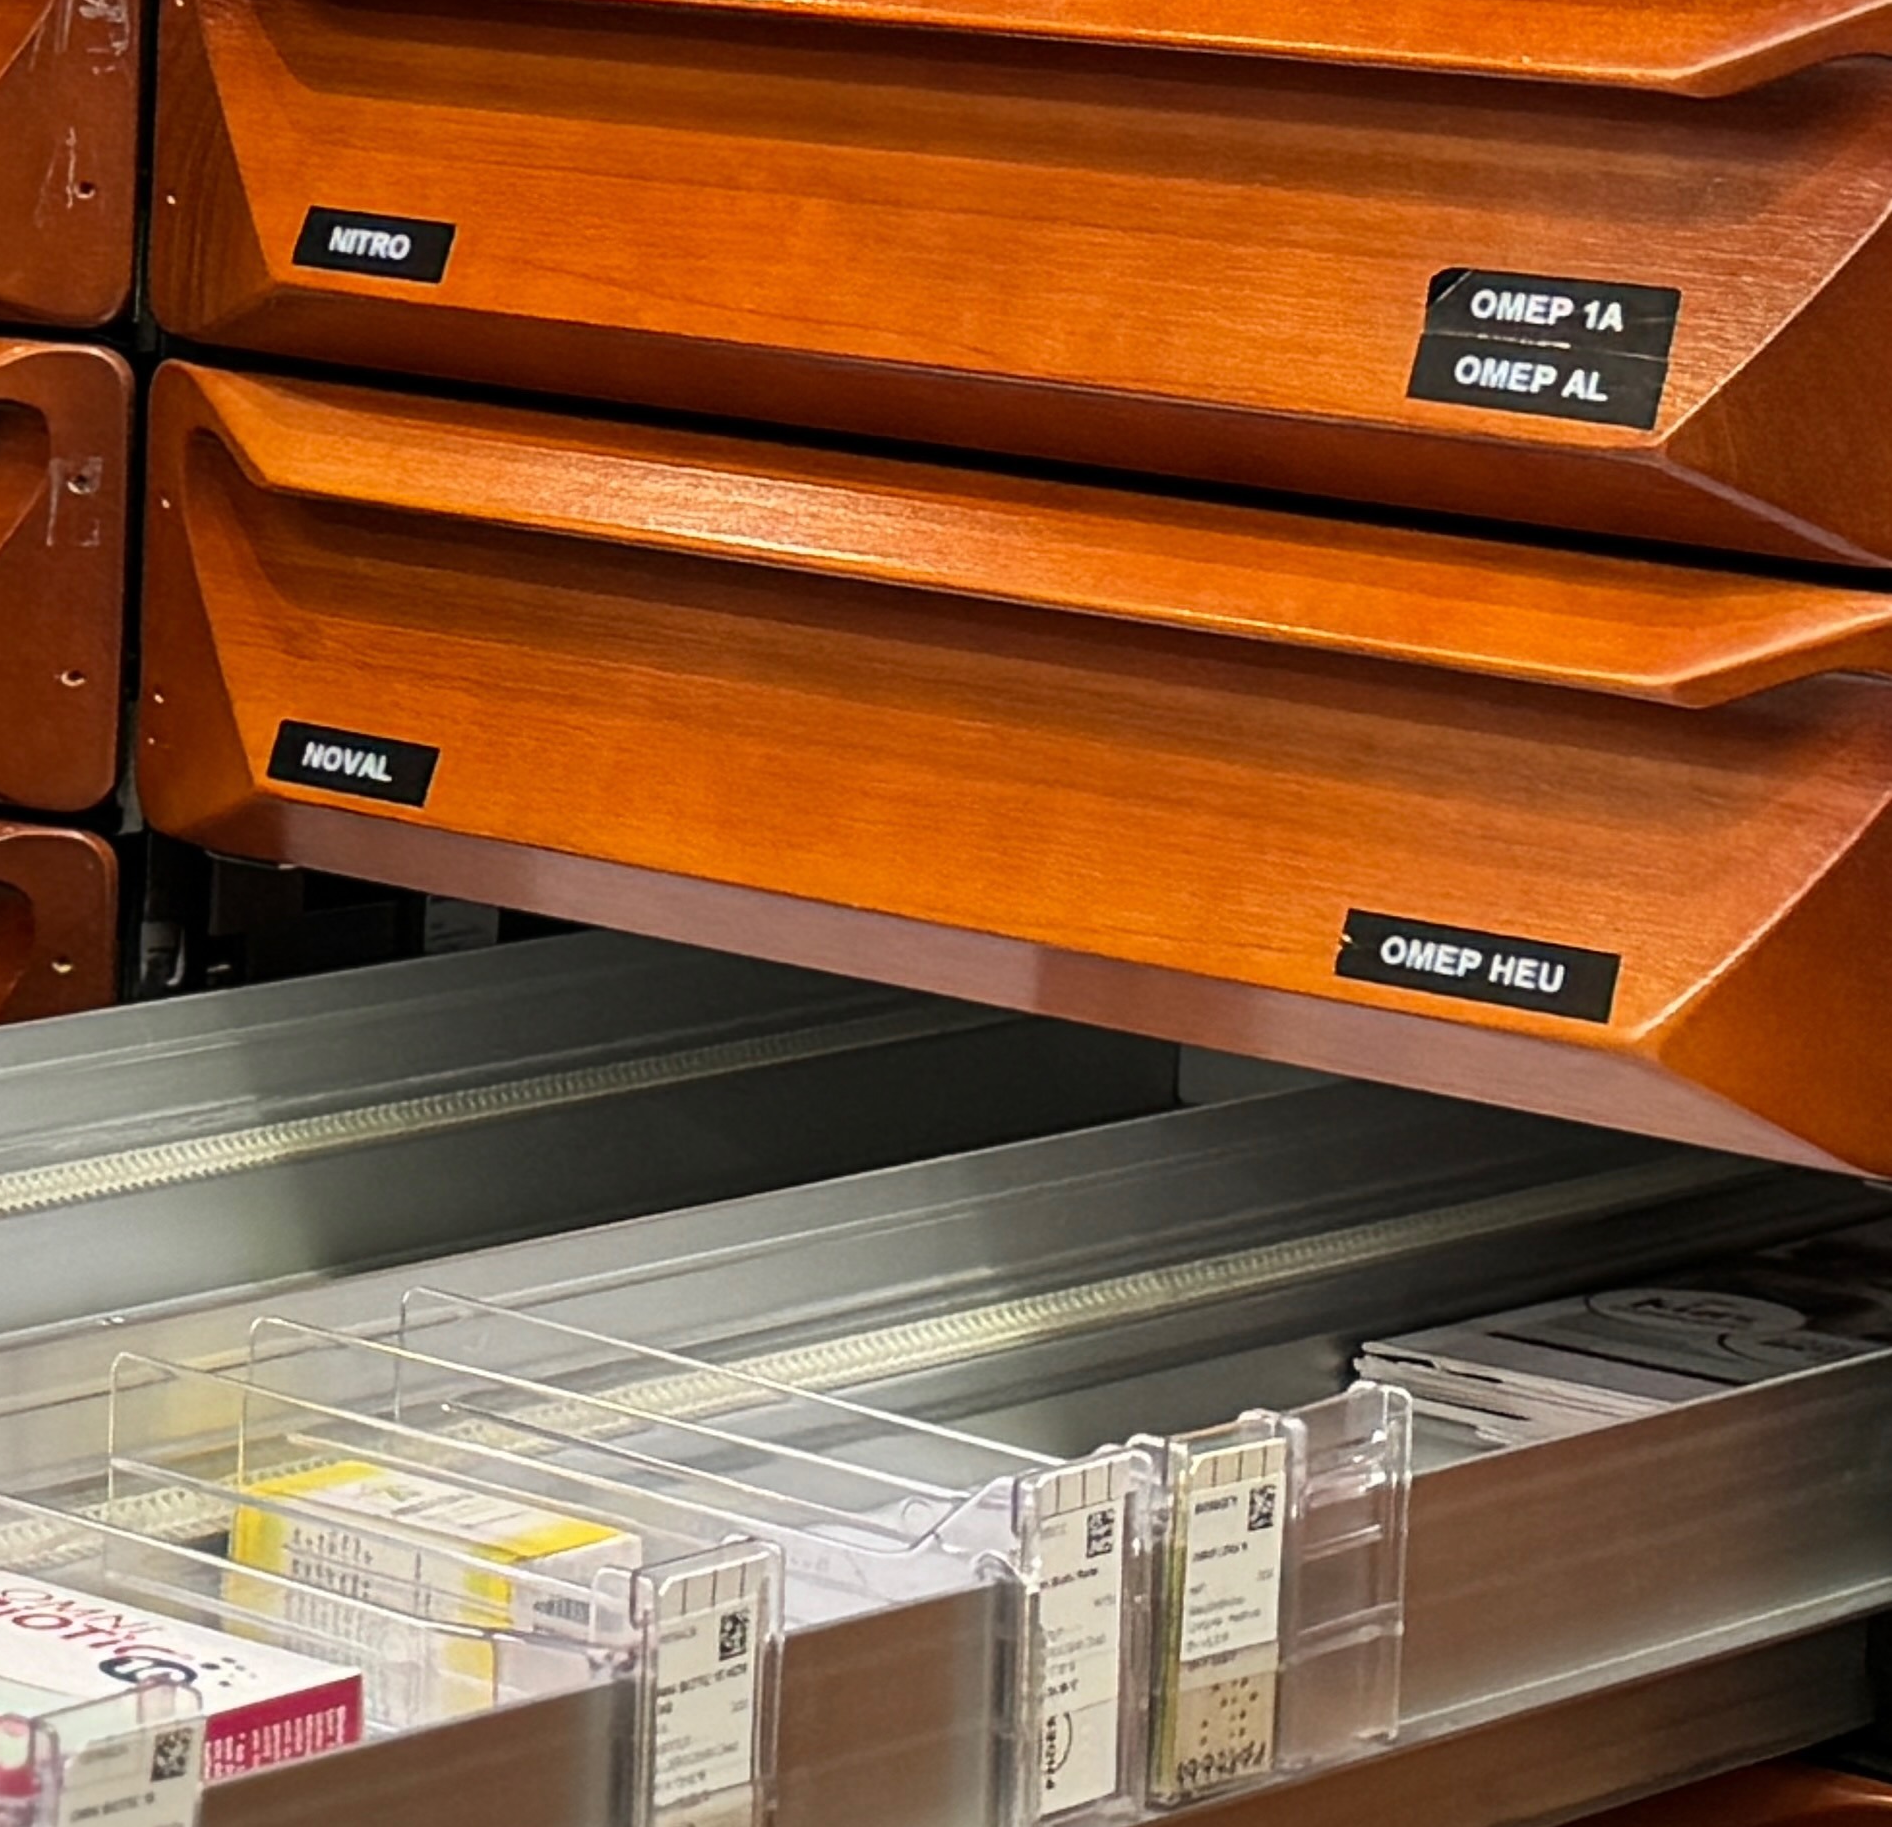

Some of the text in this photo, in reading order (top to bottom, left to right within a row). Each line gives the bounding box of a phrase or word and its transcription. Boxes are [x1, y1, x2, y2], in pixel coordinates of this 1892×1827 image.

[328, 226, 411, 260] NITRO
[1470, 288, 1624, 333] OMEP 1A
[1453, 354, 1609, 402] OMEP AL
[301, 741, 393, 782] NOVAL
[1379, 934, 1565, 993] OMEP HEU
